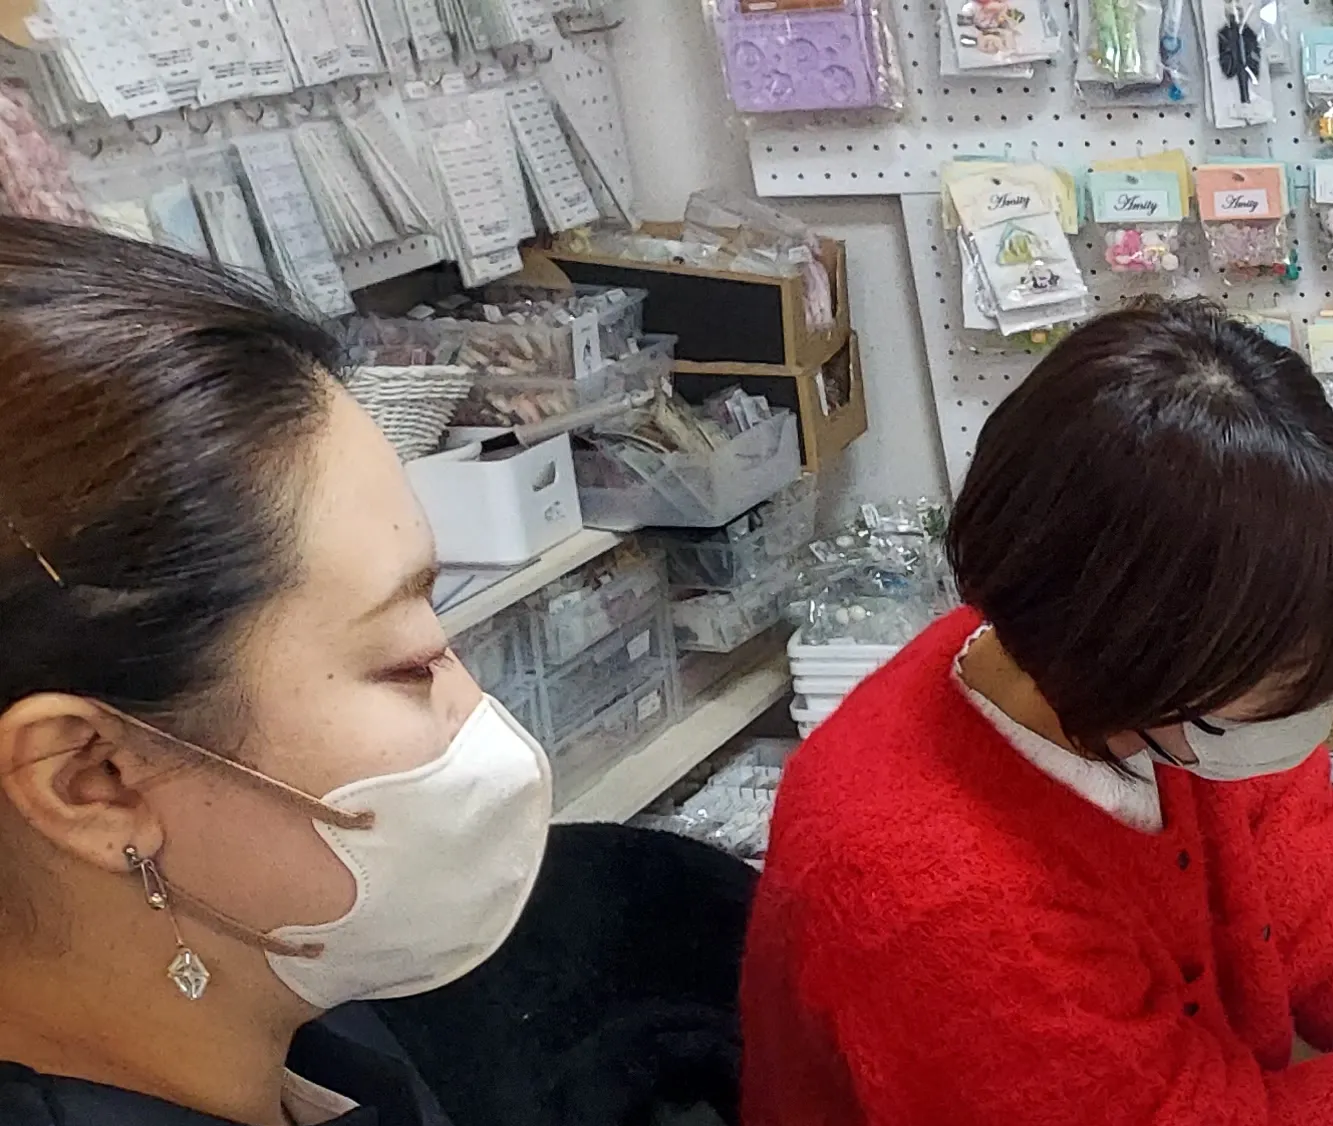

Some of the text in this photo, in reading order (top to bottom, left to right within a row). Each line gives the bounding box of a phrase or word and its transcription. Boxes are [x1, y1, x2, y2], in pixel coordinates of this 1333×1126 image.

[988, 192, 1030, 211] Amity
[1113, 193, 1157, 216] Amity
[1221, 194, 1259, 212] Amity
